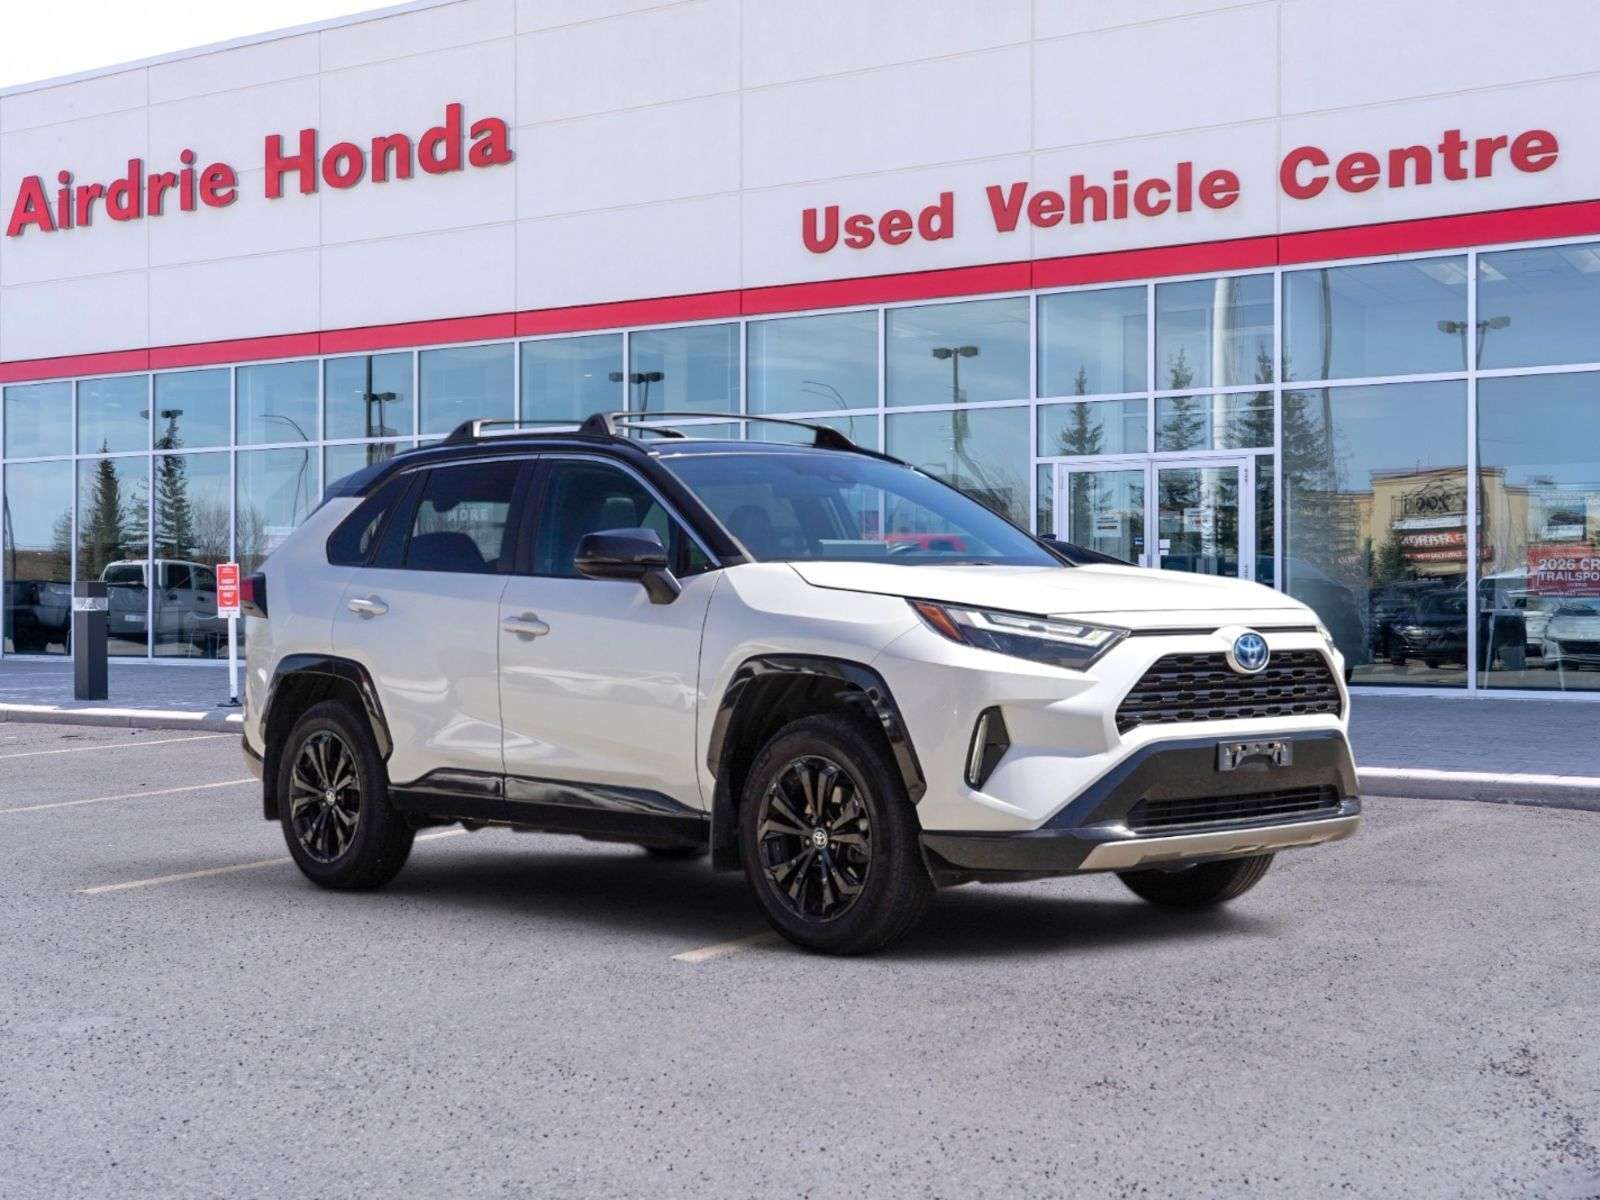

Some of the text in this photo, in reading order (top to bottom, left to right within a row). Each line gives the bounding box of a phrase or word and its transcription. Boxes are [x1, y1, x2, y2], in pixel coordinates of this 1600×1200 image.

[6, 103, 514, 236] Airdrie Honda
[802, 129, 1560, 253] Used Vehicle Centre
[1538, 558, 1576, 570] 2026
